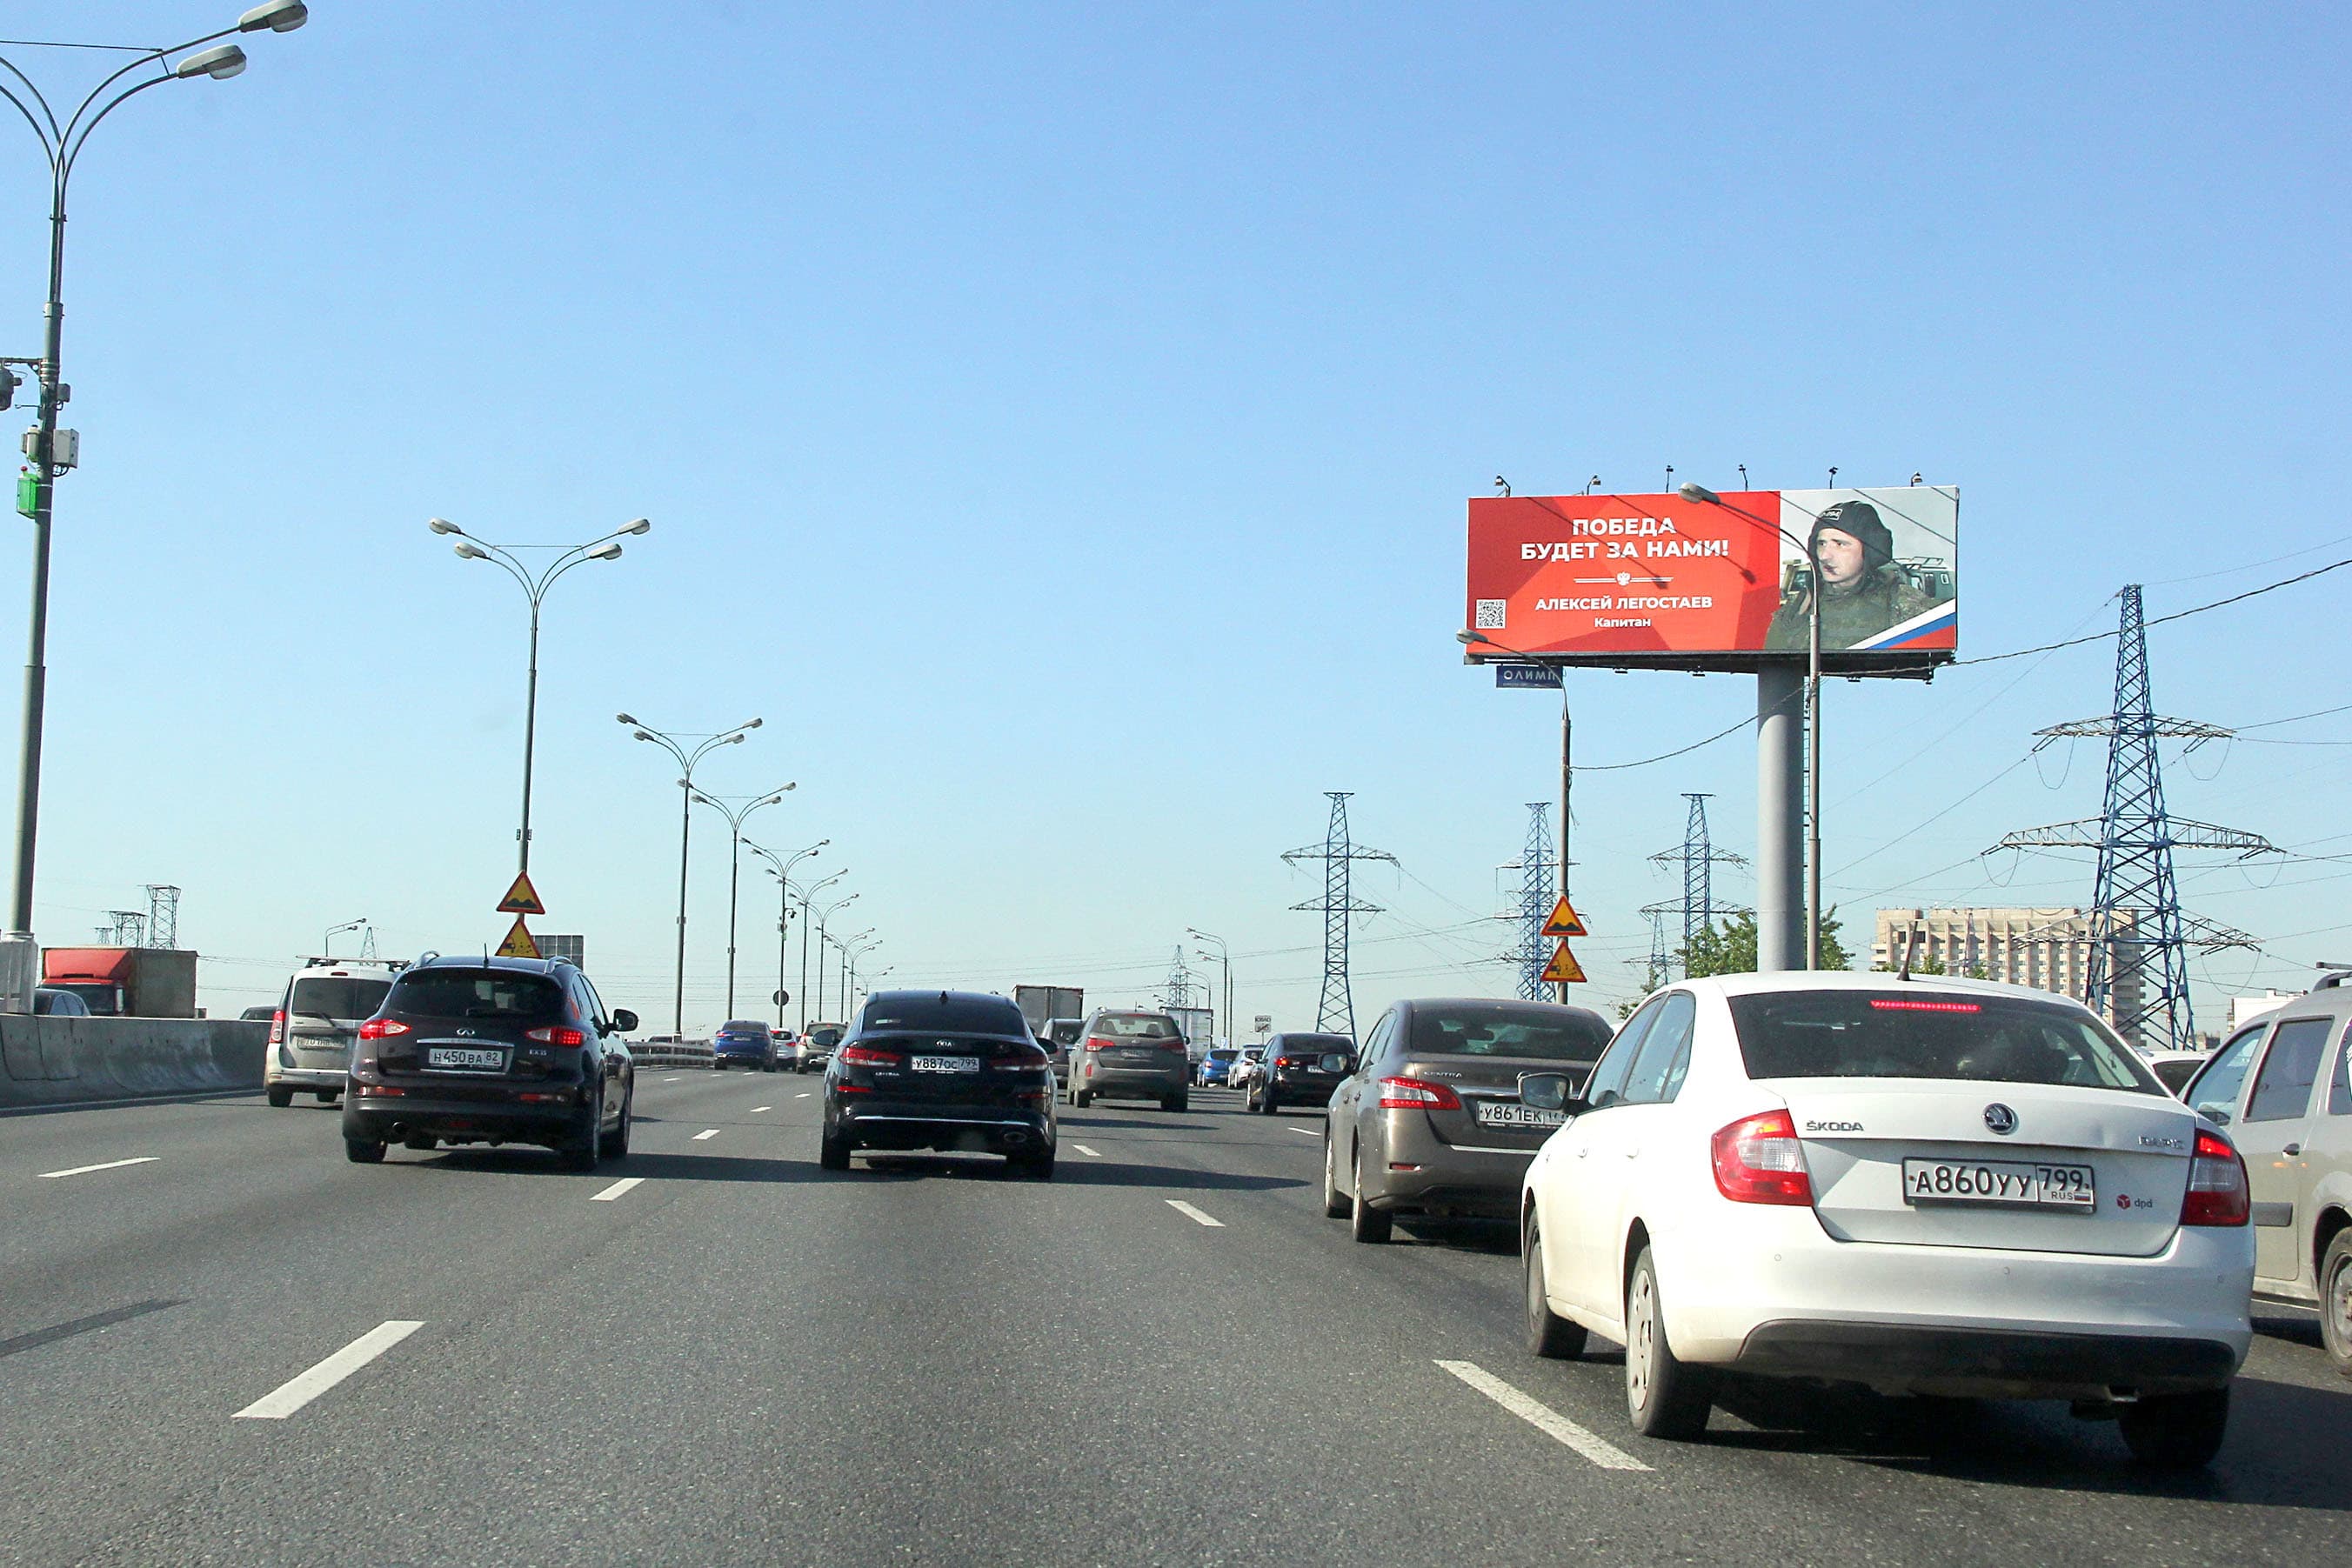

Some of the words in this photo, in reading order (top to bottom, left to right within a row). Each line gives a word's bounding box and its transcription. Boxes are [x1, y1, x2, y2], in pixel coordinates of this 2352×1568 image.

[1572, 517, 1677, 537] ПОБЕДА
[1520, 542, 1599, 562] БУДЕТ
[1606, 541, 1640, 558] ЗА
[1647, 540, 1729, 557] НАМИ!
[1534, 595, 1612, 611] АЛЕКСЕЙ
[1615, 596, 1713, 610] ЛЕГОСТАЕВ
[1594, 617, 1652, 628] Капитан
[433, 1051, 483, 1064] Н450ВА
[485, 1051, 498, 1062] 82
[915, 1058, 958, 1070] У887ОС
[1483, 1105, 1542, 1123] У861ЕК
[1806, 1120, 1865, 1131] ŠKODA
[1914, 1165, 2031, 1198] А860УУ
[2038, 1168, 2084, 1191] 799
[2051, 1191, 2074, 1200] RUS
[2134, 1198, 2154, 1210] dpd
